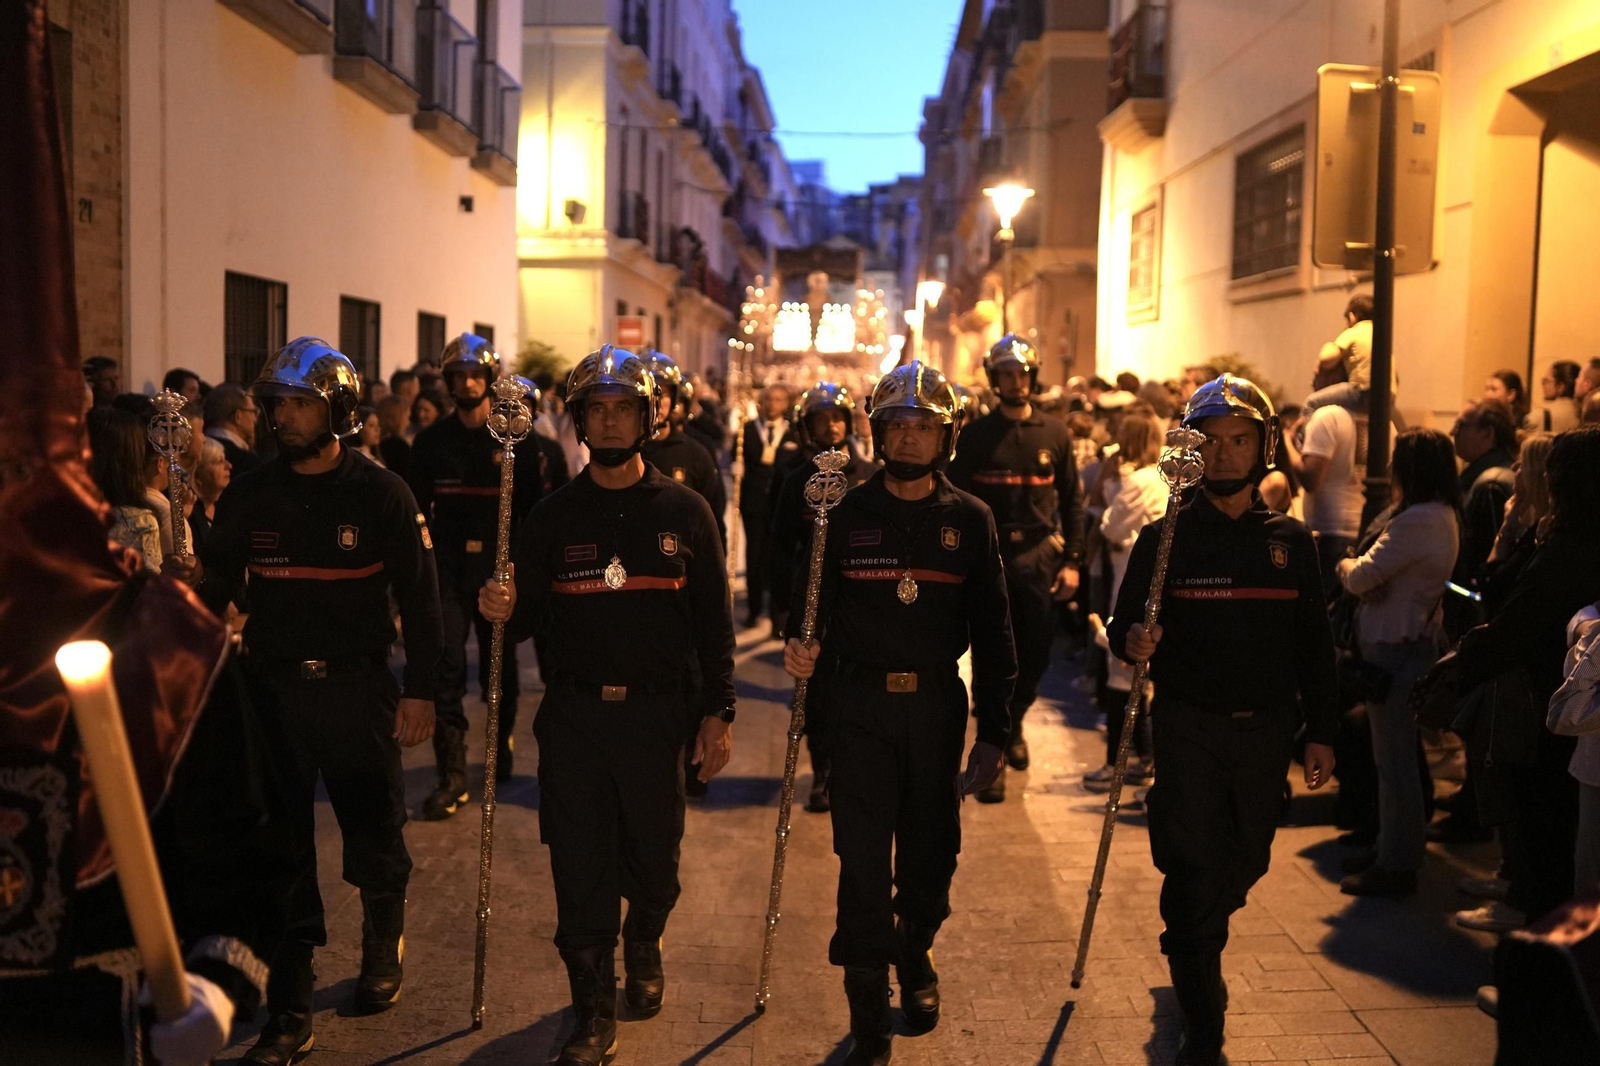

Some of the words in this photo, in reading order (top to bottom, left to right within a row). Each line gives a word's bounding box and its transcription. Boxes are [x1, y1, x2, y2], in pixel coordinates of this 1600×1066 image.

[850, 557, 898, 565] BOMBEROS
[568, 568, 607, 579] BOMBERO
[859, 570, 896, 578] MALAGA
[1185, 577, 1232, 585] BOMBEROS
[580, 582, 608, 591] MALAG
[1194, 590, 1233, 598] MALAGA
